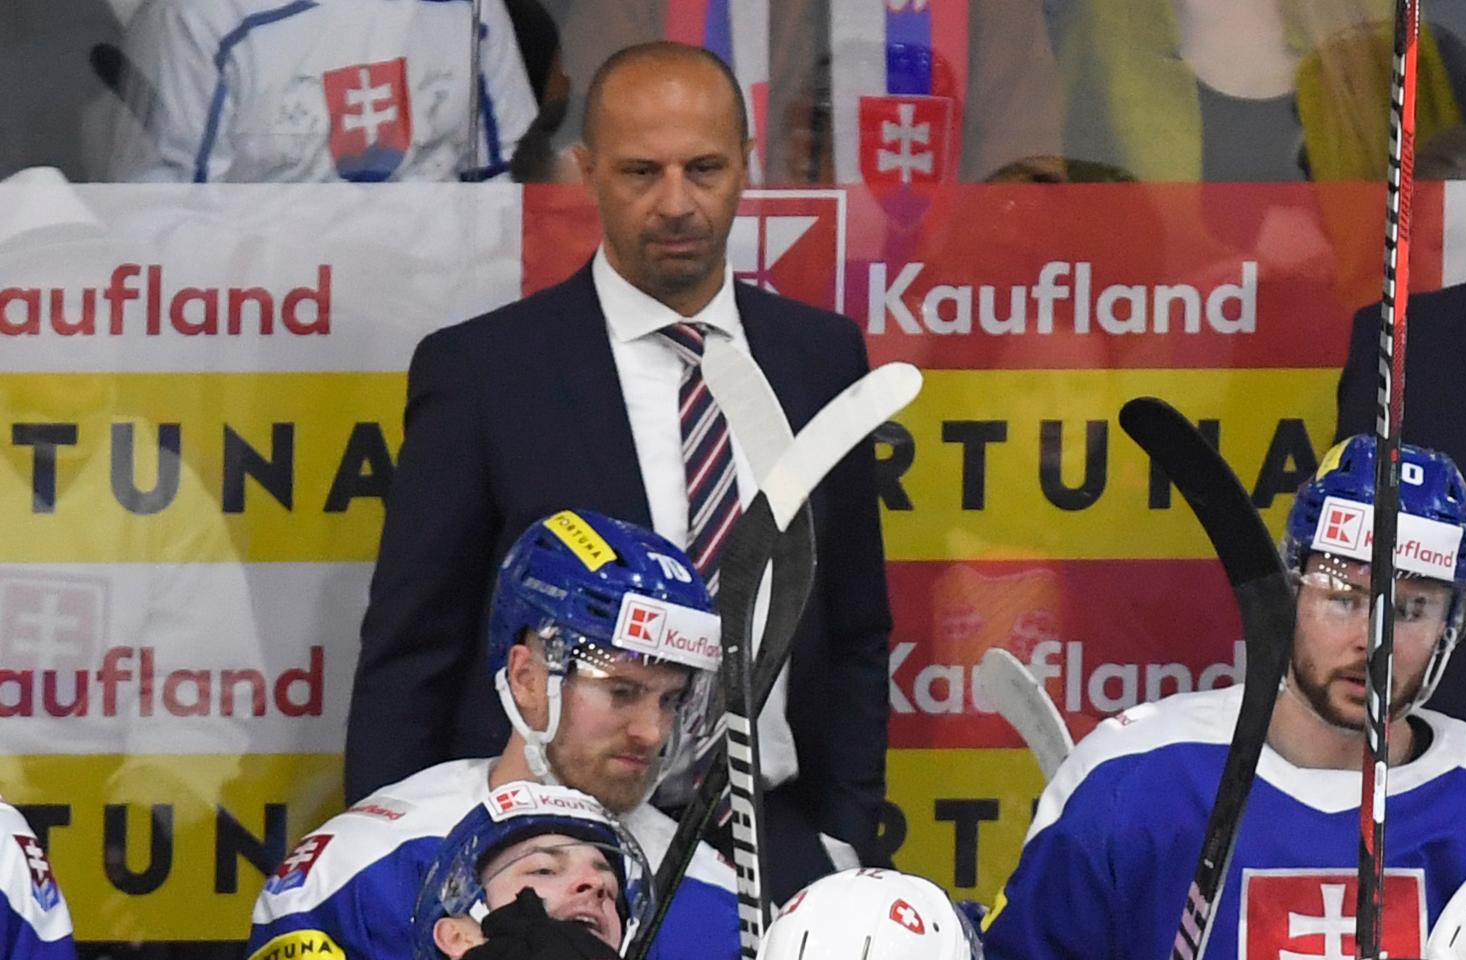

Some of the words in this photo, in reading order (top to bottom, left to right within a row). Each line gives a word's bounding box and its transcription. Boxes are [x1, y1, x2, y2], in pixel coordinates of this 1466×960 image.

[867, 261, 1258, 336] Kaufland
[555, 514, 602, 560] FORTUNA
[646, 551, 693, 584] 70
